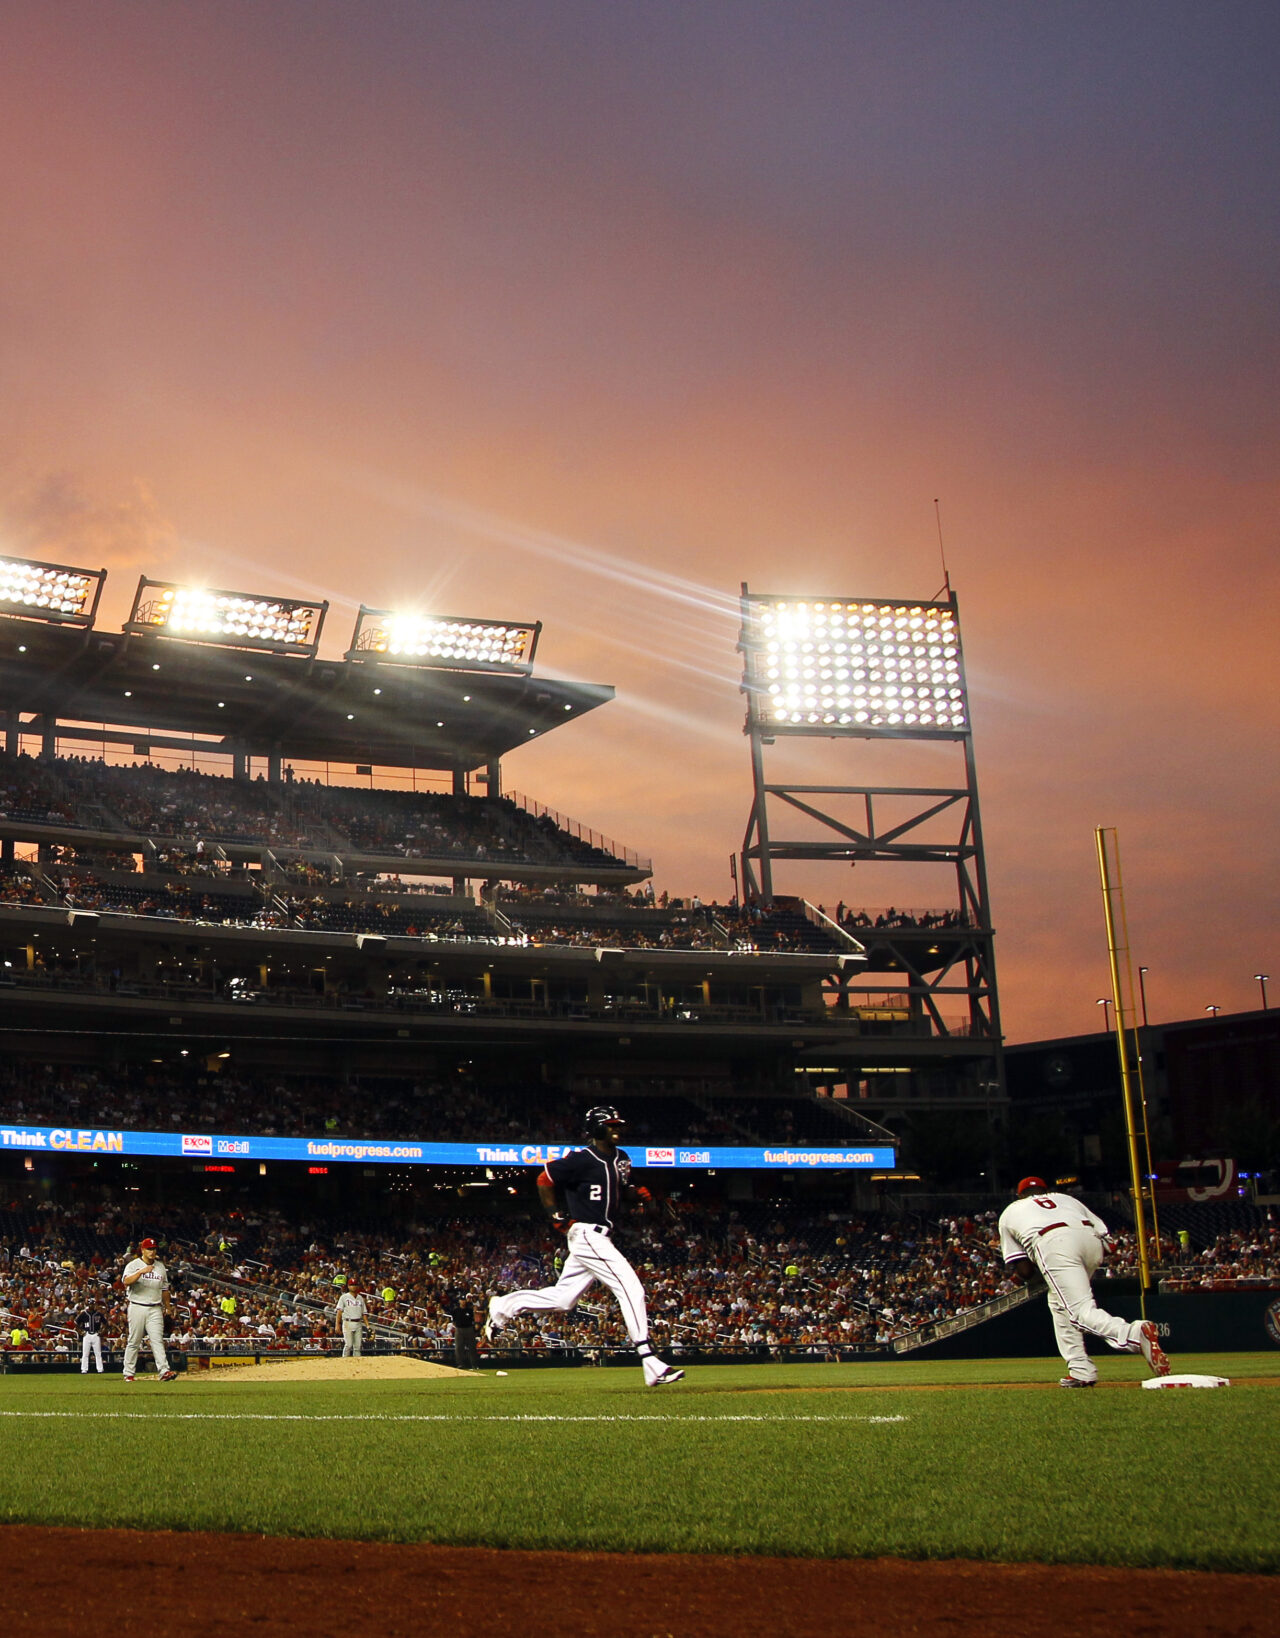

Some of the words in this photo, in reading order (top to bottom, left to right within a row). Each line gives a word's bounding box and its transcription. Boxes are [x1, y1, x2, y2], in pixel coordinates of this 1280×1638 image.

[0, 1130, 47, 1147] Think
[49, 1129, 123, 1151] CLEAN
[183, 1137, 211, 1148] EXXON
[217, 1140, 250, 1154] Mobil
[307, 1141, 422, 1158] fuelprogress.com
[476, 1147, 518, 1163] Think
[521, 1145, 581, 1164] CLEA
[647, 1149, 674, 1159] EXXON
[679, 1151, 710, 1164] Mobil
[763, 1149, 874, 1166] fuelprogress.com
[589, 1185, 602, 1201] 2
[1033, 1197, 1057, 1210] 6
